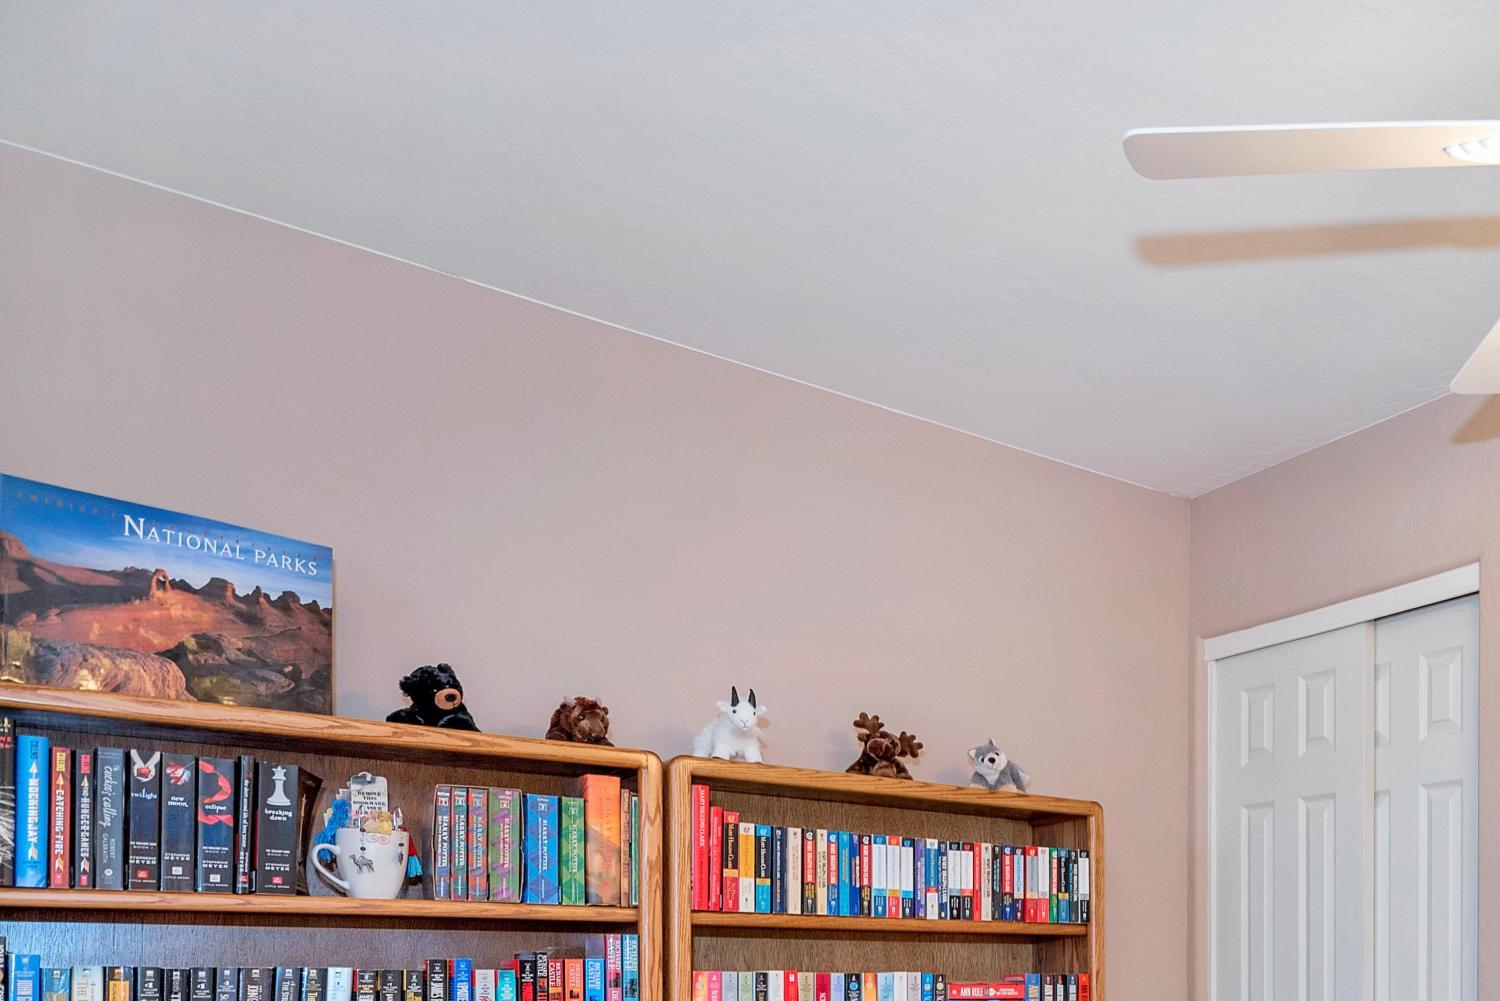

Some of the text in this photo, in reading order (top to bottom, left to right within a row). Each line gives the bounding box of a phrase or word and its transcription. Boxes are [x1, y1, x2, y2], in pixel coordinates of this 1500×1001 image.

[123, 515, 318, 576] NATIONAL PARKS
[131, 788, 157, 799] twilight
[27, 779, 39, 842] MOCKINGJAY
[99, 797, 116, 827] calling
[265, 808, 292, 818] breaking
[55, 789, 65, 854] CATCHING FIRE
[17, 980, 32, 994] JOHN
[248, 985, 259, 998] JOHN
[431, 982, 443, 998] JAMES
[307, 992, 317, 1001] THE
